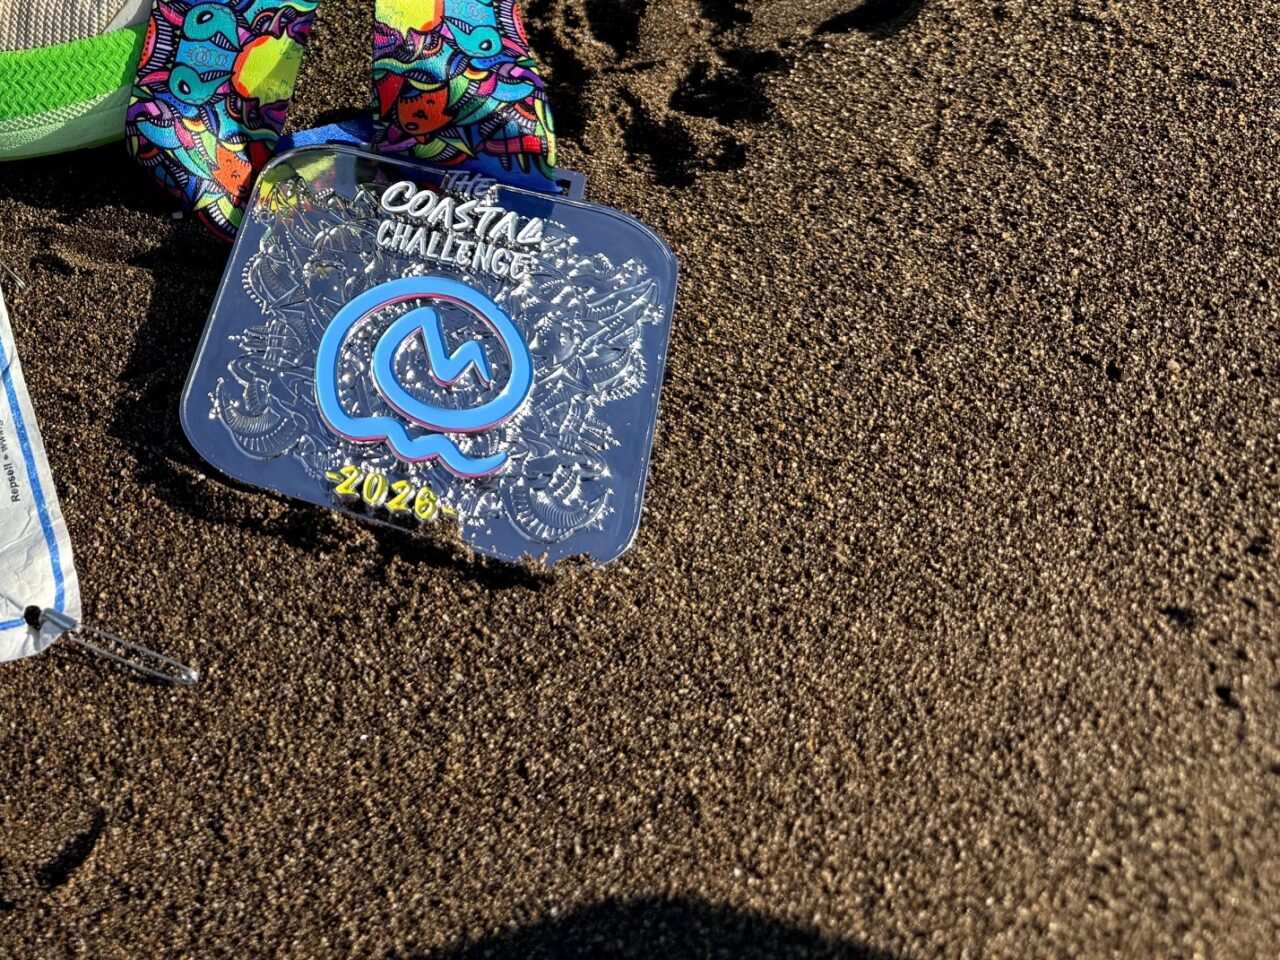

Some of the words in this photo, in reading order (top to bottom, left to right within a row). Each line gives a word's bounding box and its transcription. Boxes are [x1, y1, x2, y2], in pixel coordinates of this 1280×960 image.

[445, 170, 497, 198] THE
[381, 181, 544, 244] COASTAL
[377, 220, 532, 280] CHALLENGE
[2, 463, 21, 503] Repsell
